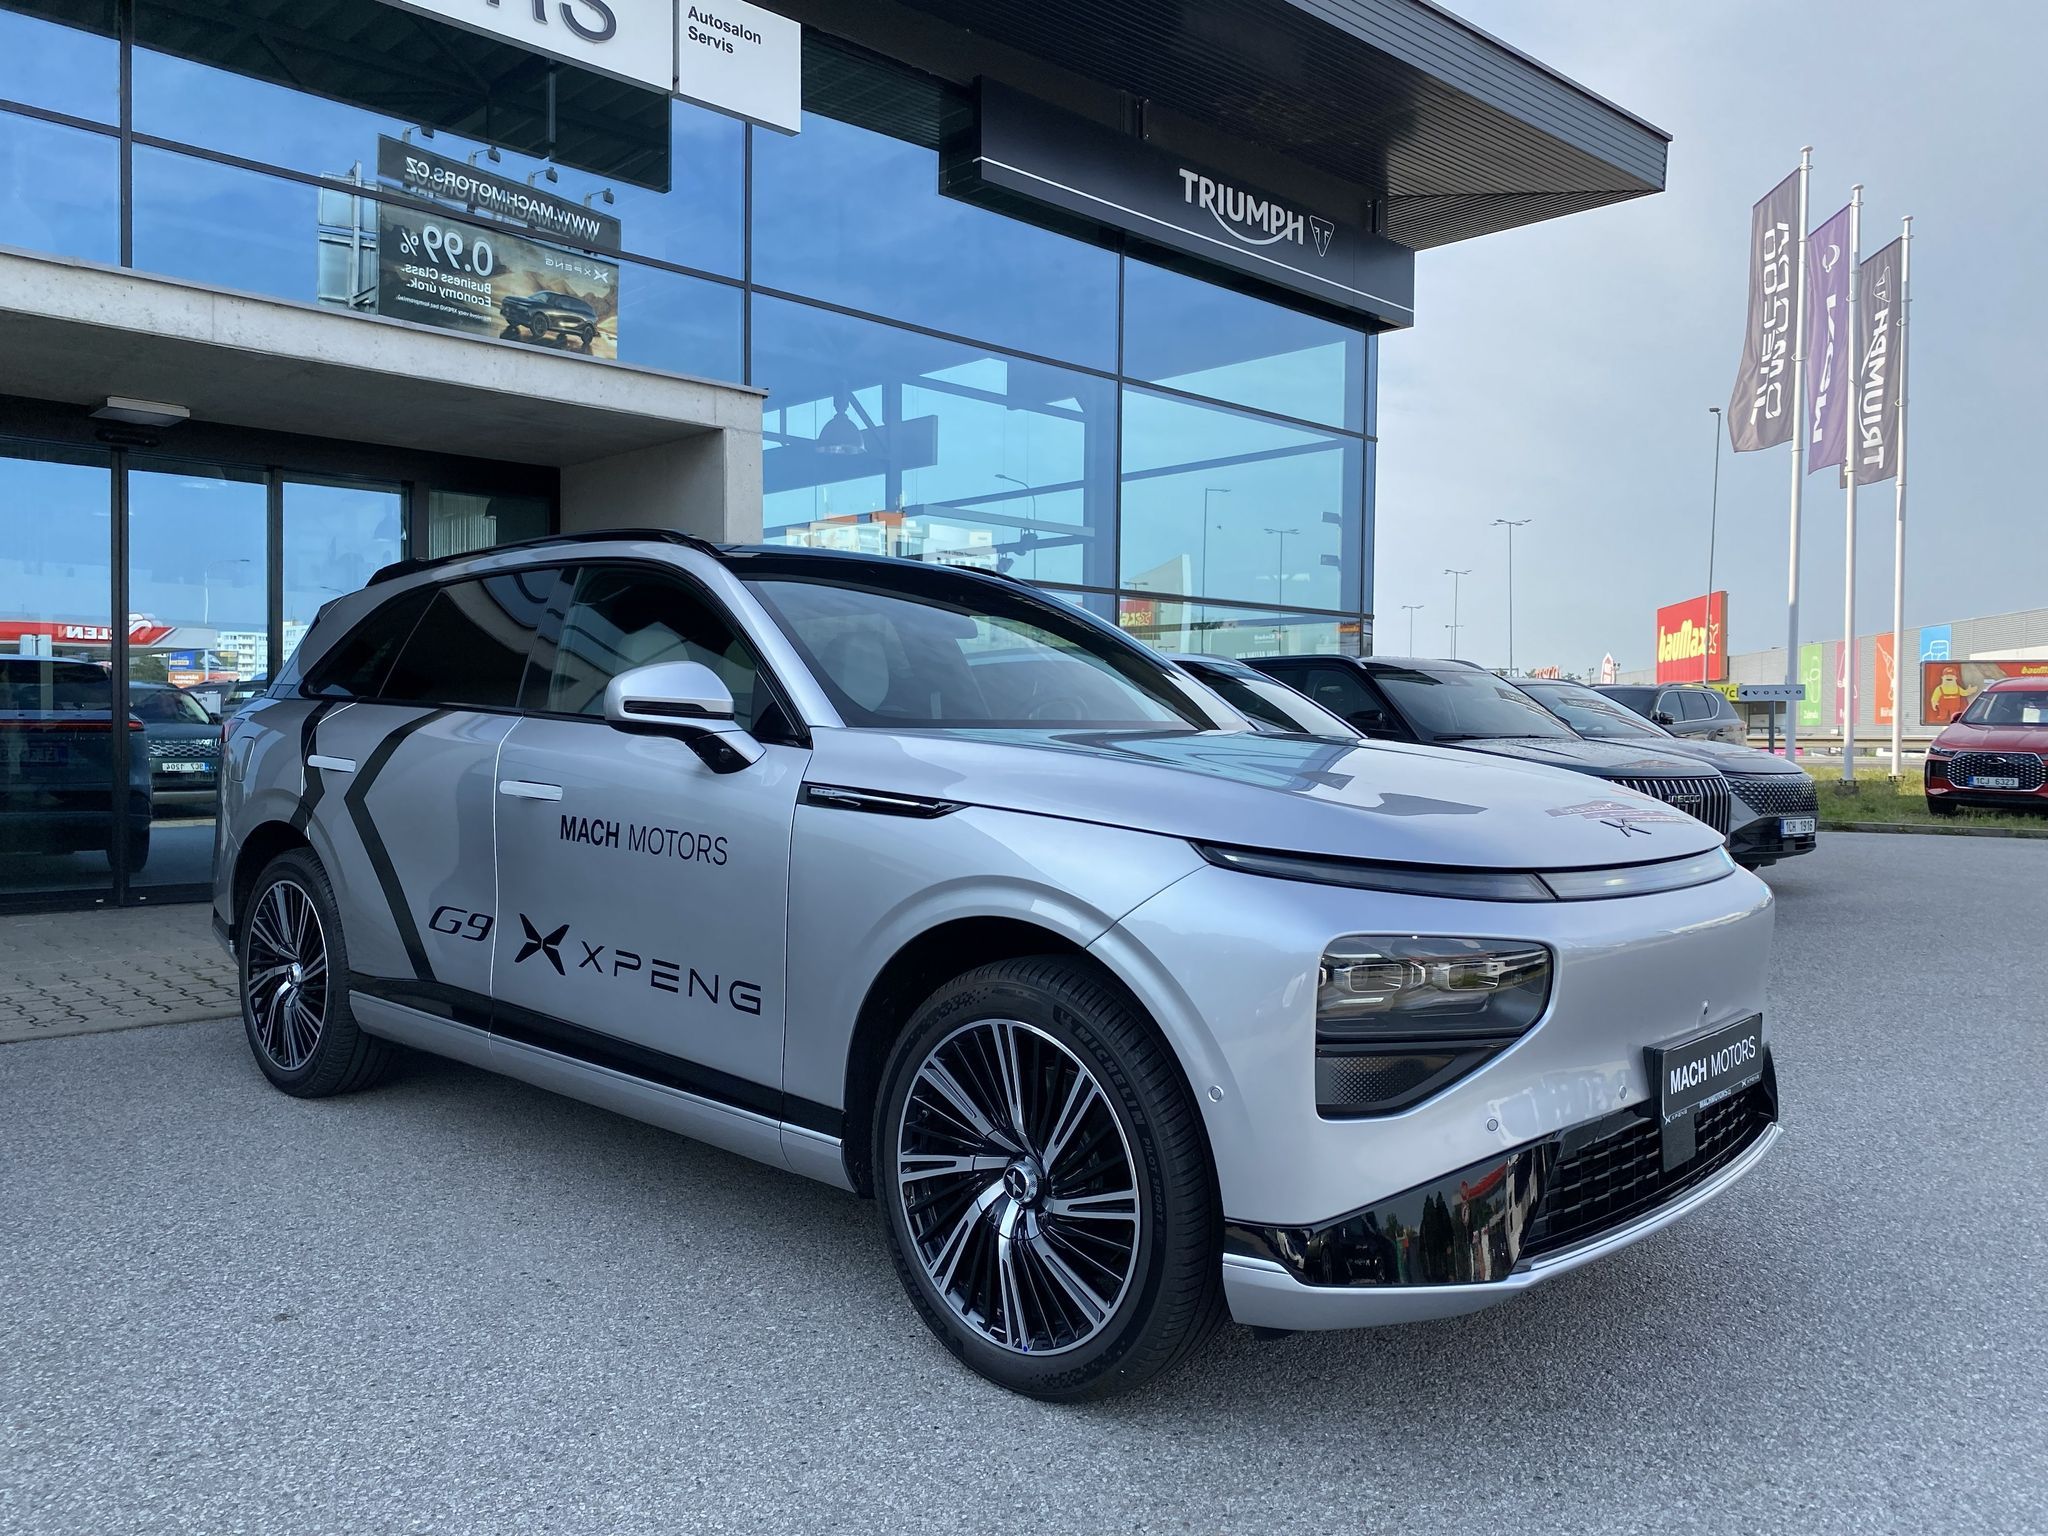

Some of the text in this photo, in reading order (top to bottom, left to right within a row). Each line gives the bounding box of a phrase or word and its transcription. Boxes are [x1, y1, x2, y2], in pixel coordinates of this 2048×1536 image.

[687, 5, 762, 45] Autosalon
[687, 25, 734, 54] Servis
[1178, 168, 1305, 246] TRIUMPH
[1975, 777, 2015, 786] 1CJ 6323
[559, 814, 728, 866] MACH MOTORS
[1785, 818, 1813, 832] 1CH 1916
[428, 905, 494, 943] G9
[578, 940, 762, 1017] XPENG
[1074, 1026, 1146, 1126] MICHELIN
[1670, 1035, 1756, 1095] MACH MOTORS
